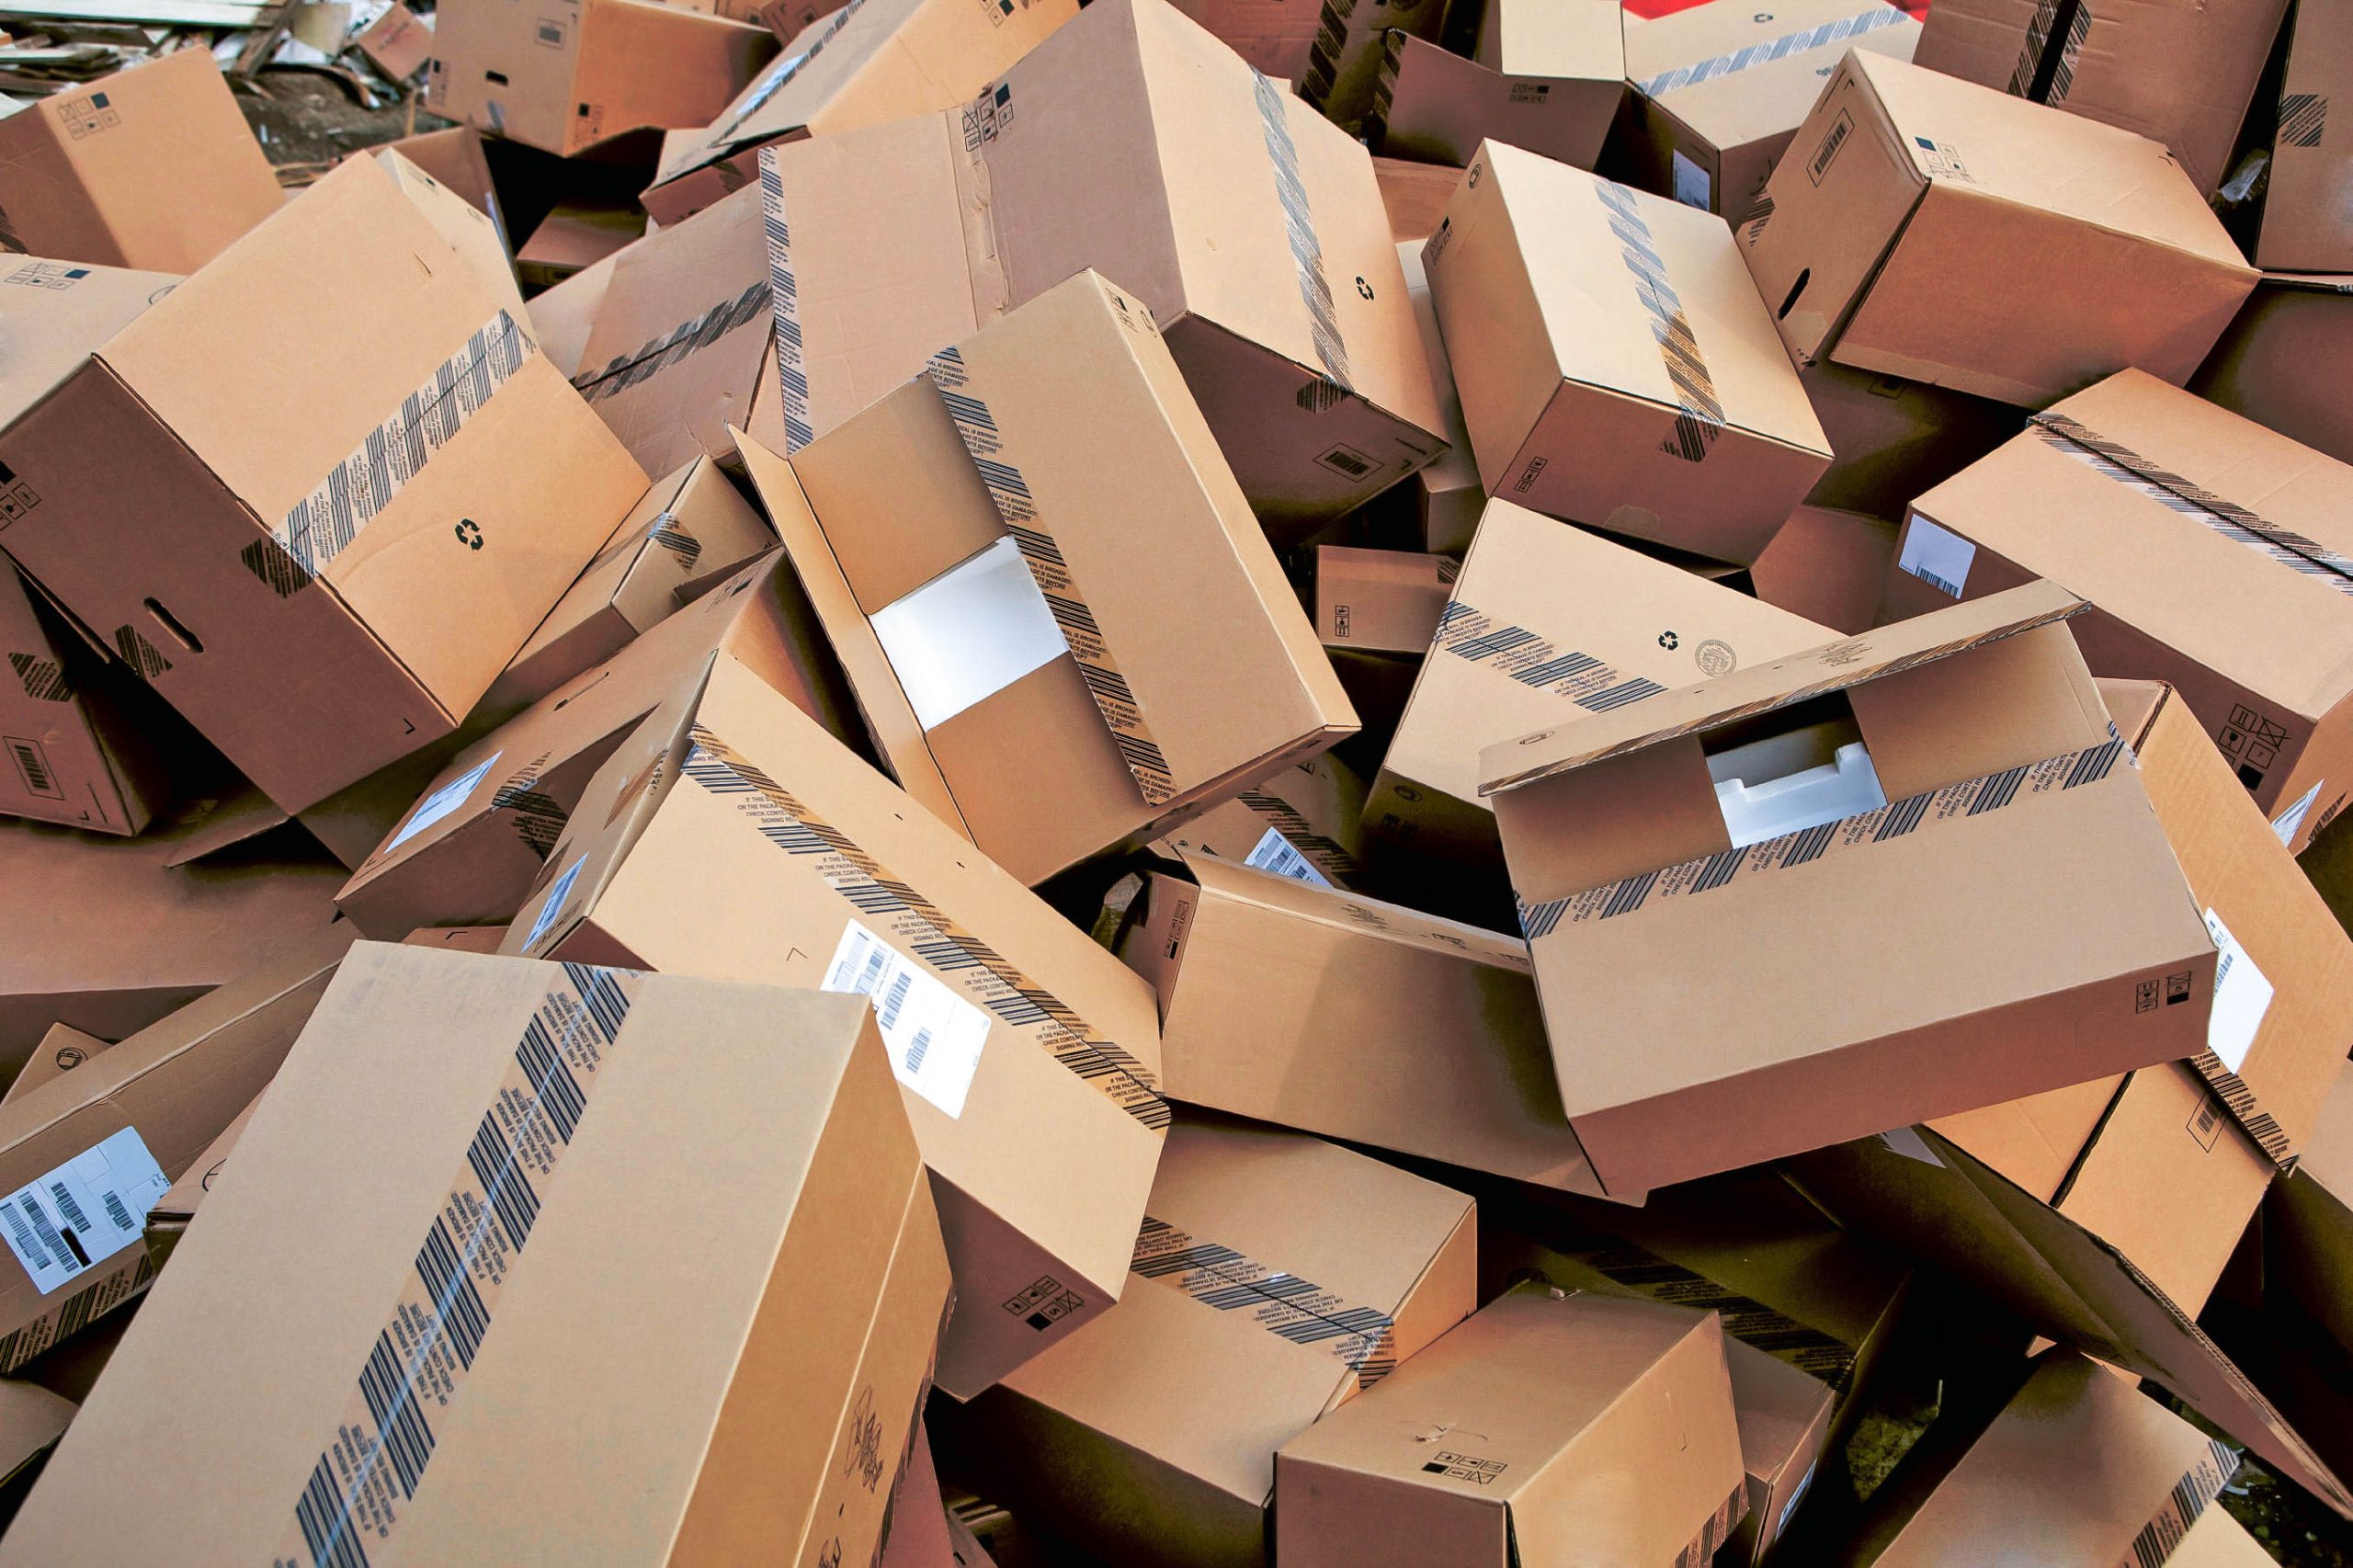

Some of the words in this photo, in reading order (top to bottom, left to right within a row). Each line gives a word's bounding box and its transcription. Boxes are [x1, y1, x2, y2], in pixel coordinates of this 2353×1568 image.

[941, 365, 964, 373] BROKEN
[976, 431, 998, 439] BROKEN
[1010, 498, 1032, 507] BROKEN
[1043, 567, 1066, 575] BROKEN
[2036, 761, 2046, 775] THIS
[2032, 783, 2041, 793] OR
[2038, 773, 2048, 784] THE
[2043, 772, 2058, 790] CHECK
[1940, 788, 1951, 801] THIS
[1938, 810, 1946, 819] OR
[1943, 800, 1952, 811] THE
[1948, 799, 1962, 817] CHECK
[1847, 814, 1858, 828] THIS
[1844, 836, 1852, 846] OR
[1849, 826, 1859, 837] THE
[1854, 824, 1868, 843] CHECK
[1755, 840, 1765, 854] THIS
[1751, 863, 1759, 872] OR
[1756, 852, 1767, 864] THE
[1762, 851, 1776, 869] CHECK
[540, 1006, 559, 1028] BROKEN
[566, 1050, 578, 1061] THIS
[579, 1051, 591, 1063] THE
[585, 1042, 601, 1061] CHECK
[585, 1062, 596, 1072] OR
[494, 1103, 513, 1127] BROKEN
[519, 1149, 531, 1161] THIS
[533, 1152, 546, 1165] THE
[540, 1142, 557, 1163] CHECK
[540, 1164, 551, 1173] OR
[1266, 1316, 1290, 1325] BROKEN
